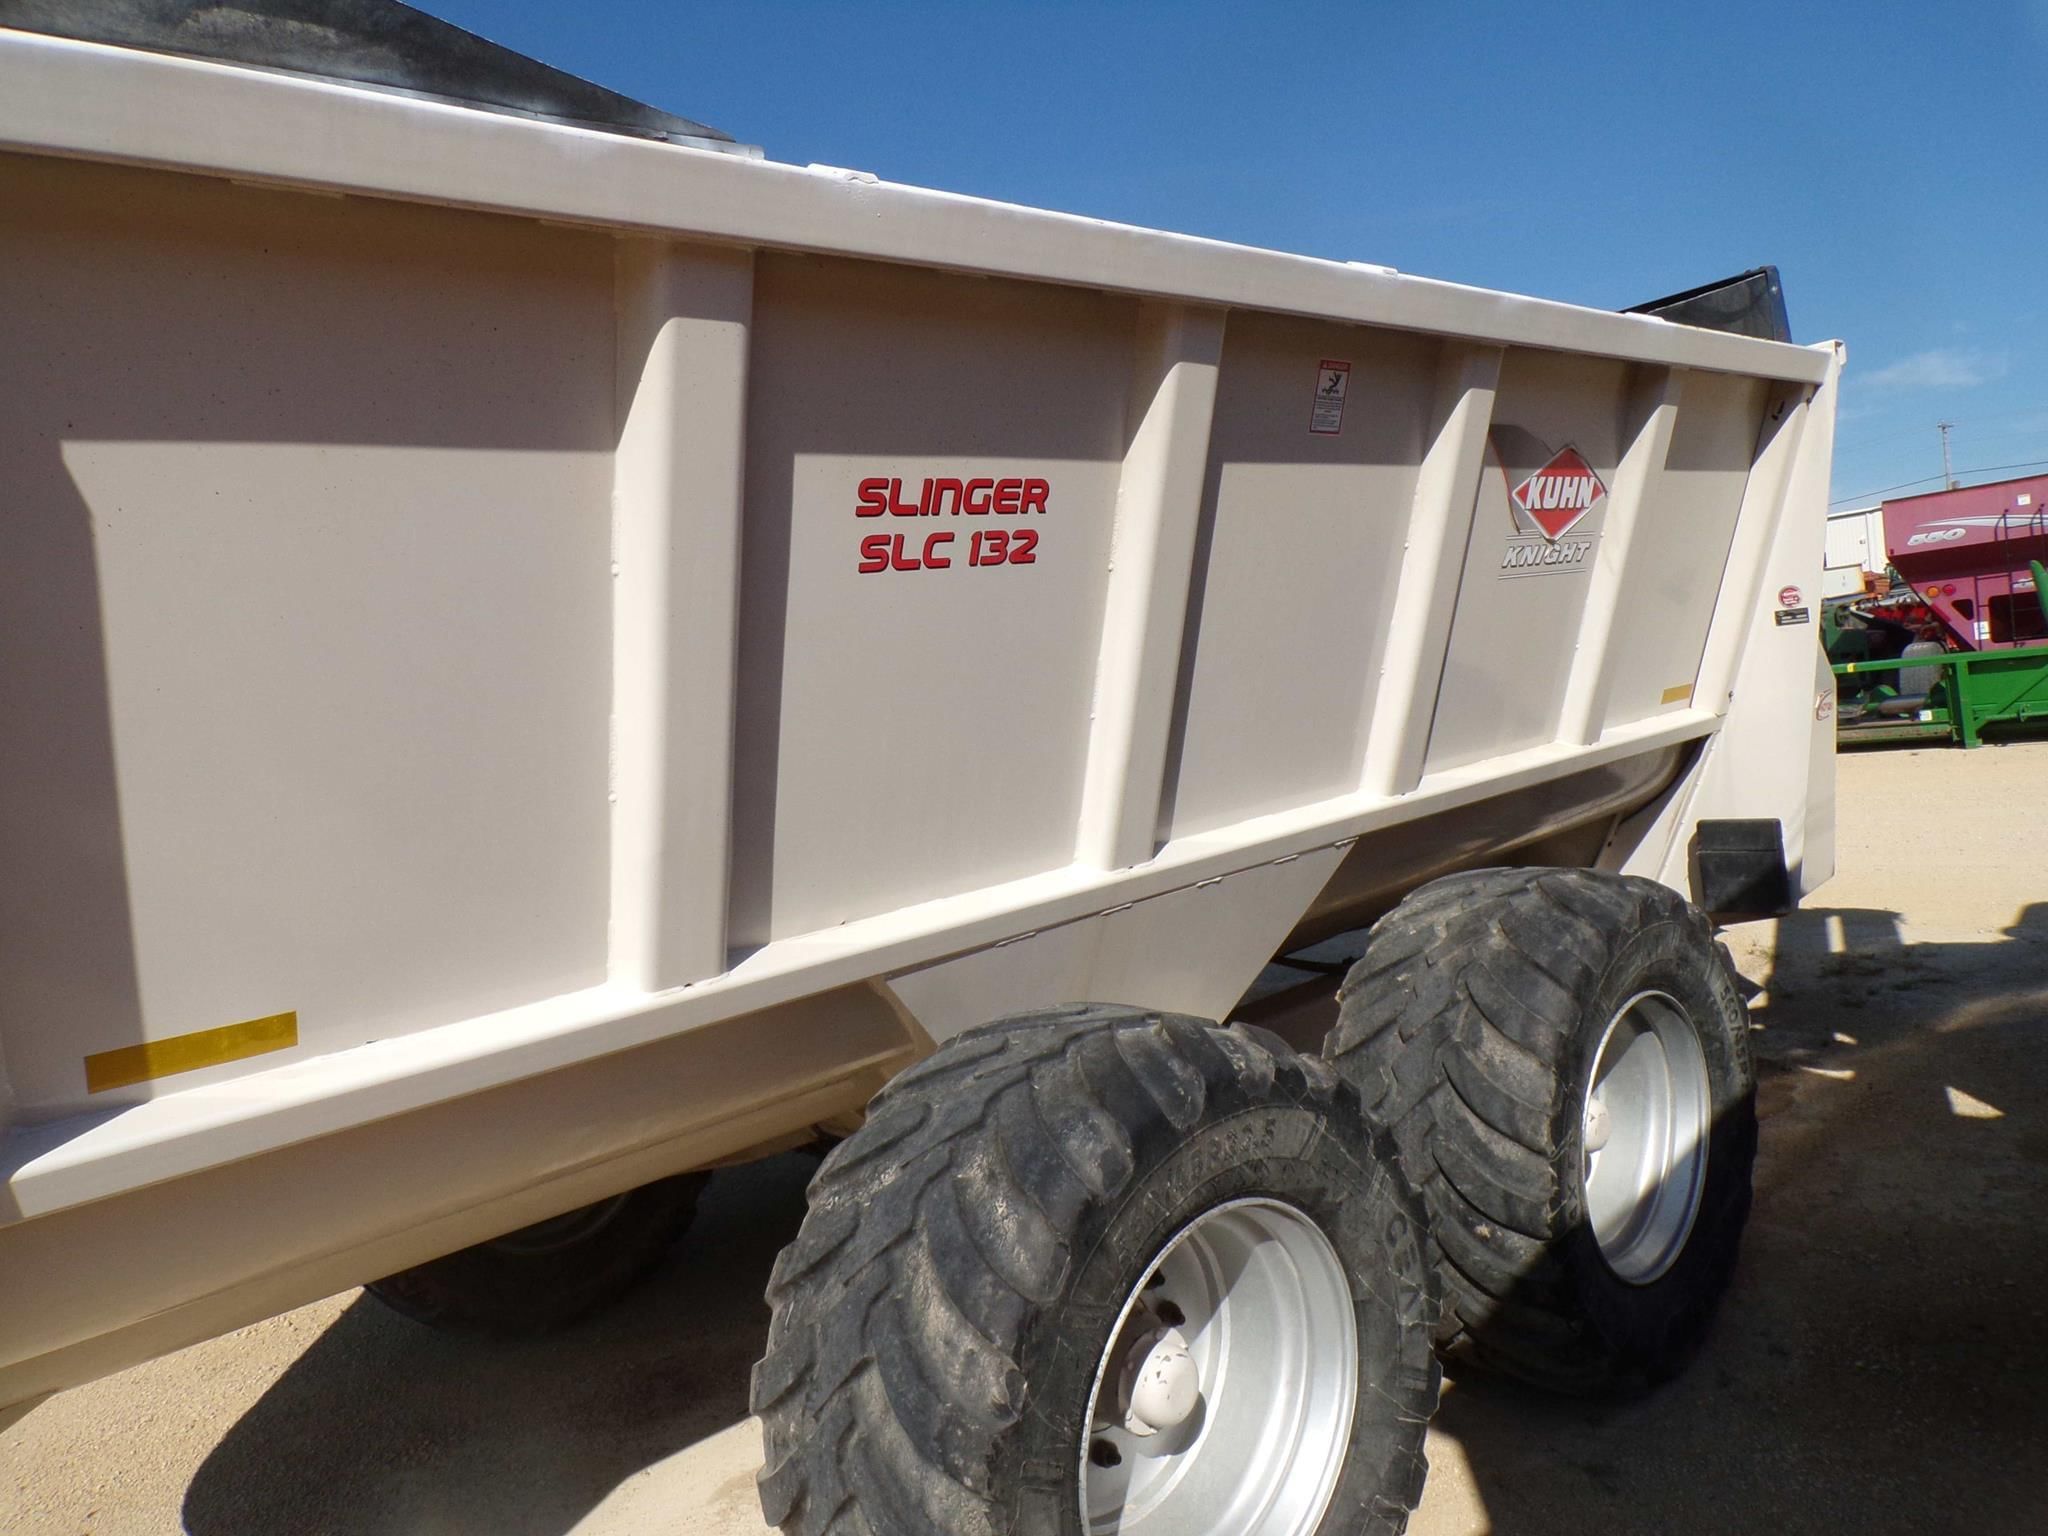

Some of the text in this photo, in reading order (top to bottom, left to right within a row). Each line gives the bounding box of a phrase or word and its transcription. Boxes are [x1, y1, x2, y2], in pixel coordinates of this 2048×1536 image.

[855, 477, 1050, 517] SLINGER
[1525, 476, 1595, 509] KUHN
[858, 529, 1039, 573] SLC 132
[1501, 542, 1591, 569] KNIGHT
